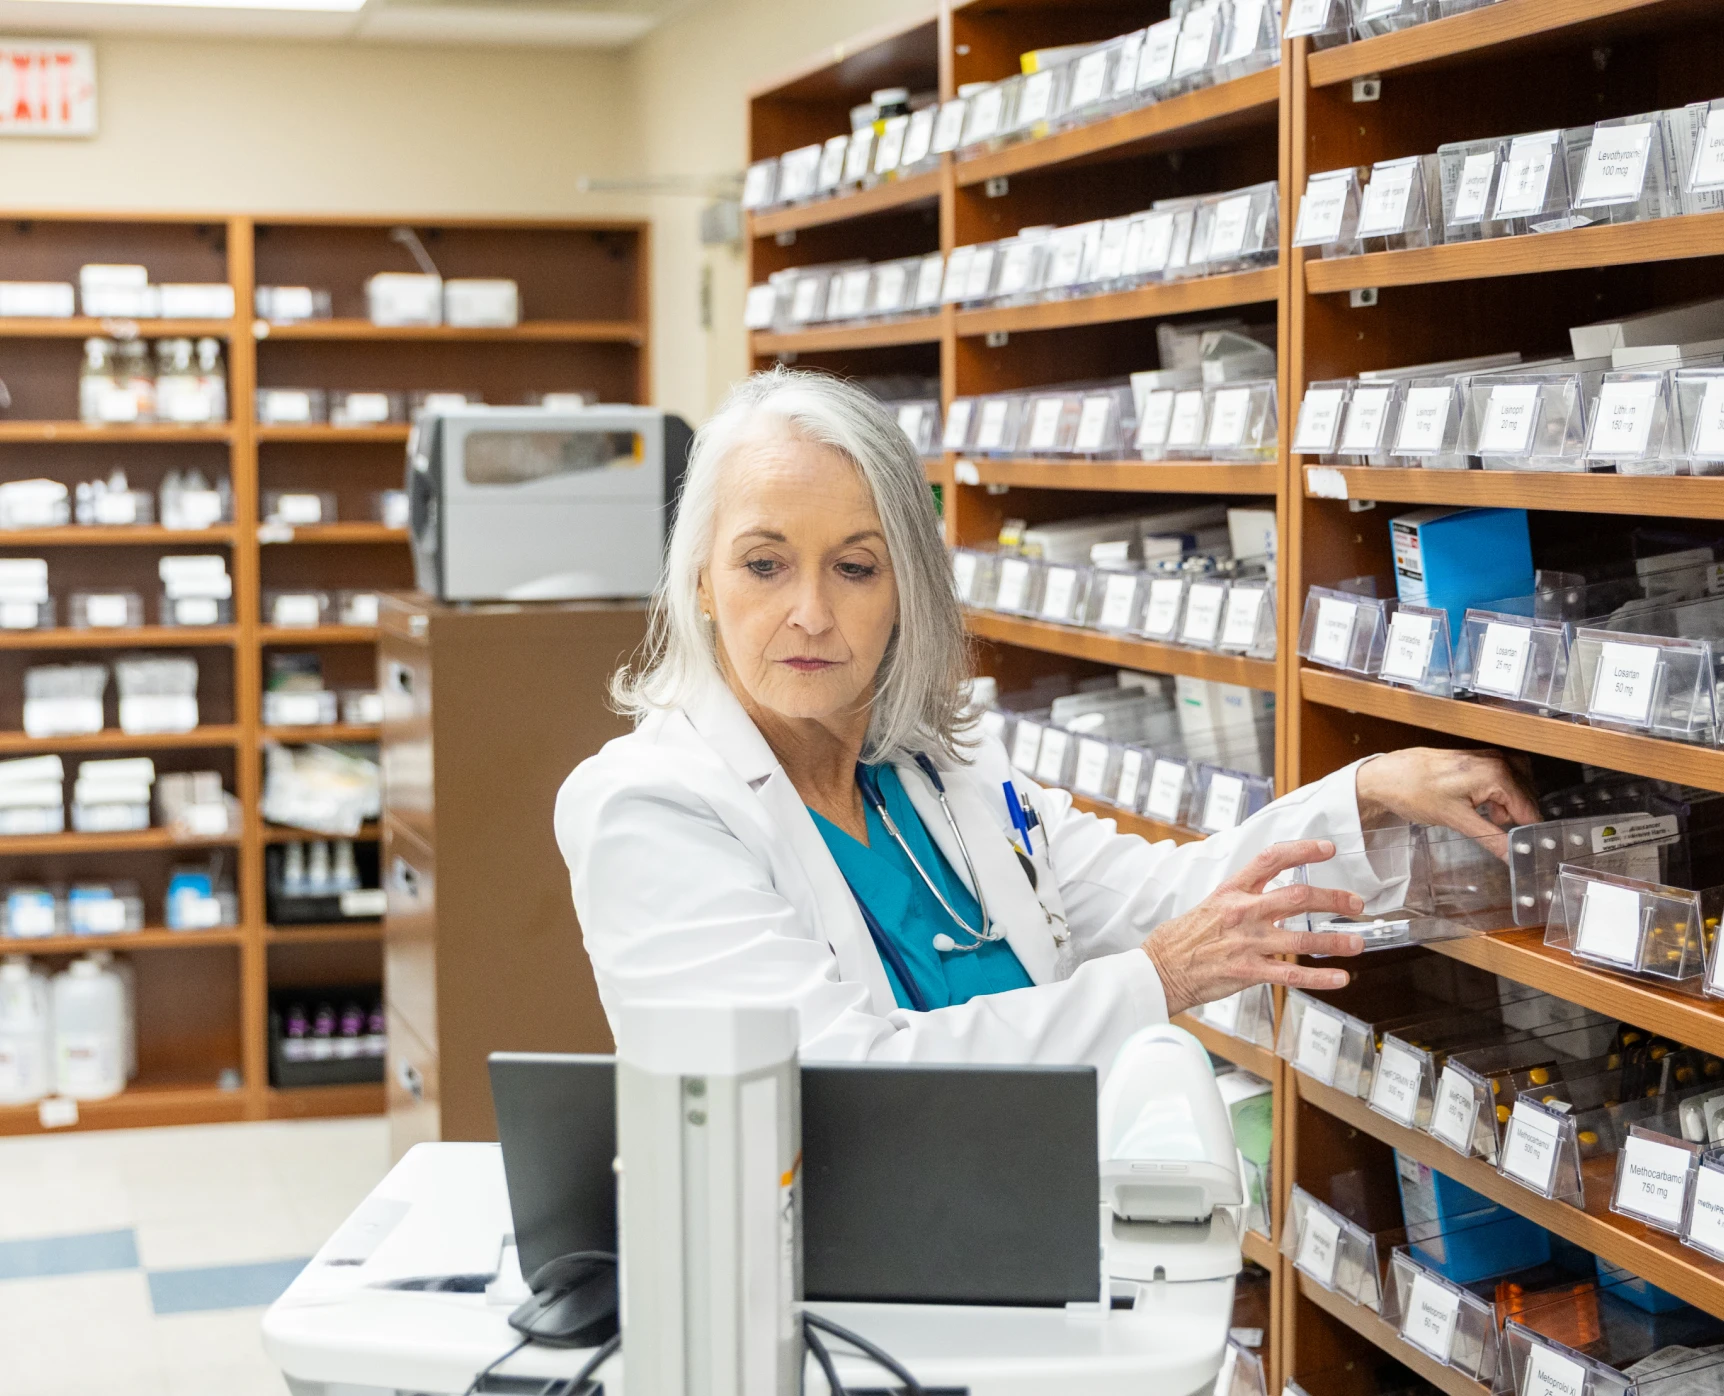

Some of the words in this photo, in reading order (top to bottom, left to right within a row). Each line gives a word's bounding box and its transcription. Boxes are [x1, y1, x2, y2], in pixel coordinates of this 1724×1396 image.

[0, 52, 73, 122] XIT
[1602, 166, 1614, 176] 100
[1615, 165, 1629, 178] mcg
[1501, 404, 1525, 415] Lisinopril
[1423, 422, 1432, 432] mg
[1501, 419, 1508, 429] 20
[1508, 420, 1518, 431] mg
[1611, 419, 1622, 430] 150
[1623, 420, 1633, 432] mg
[1406, 649, 1414, 660] mg
[1495, 645, 1518, 657] Losartan
[1495, 659, 1503, 669] 25
[1503, 661, 1513, 673] mg
[1613, 666, 1640, 680] Losartan
[1614, 682, 1623, 693] 50
[1624, 684, 1634, 697] mg
[1397, 1090, 1405, 1101] mg
[1517, 1128, 1550, 1151] Methocarbamol
[1524, 1143, 1534, 1154] 500
[1533, 1148, 1541, 1160] mg
[1629, 1163, 1685, 1185] Methocarbamol
[1641, 1182, 1655, 1194] 750
[1656, 1187, 1668, 1199] mg
[1421, 1300, 1448, 1322] Metoprolol
[1431, 1323, 1440, 1335] mg
[1537, 1369, 1569, 1394] Metoprolol
